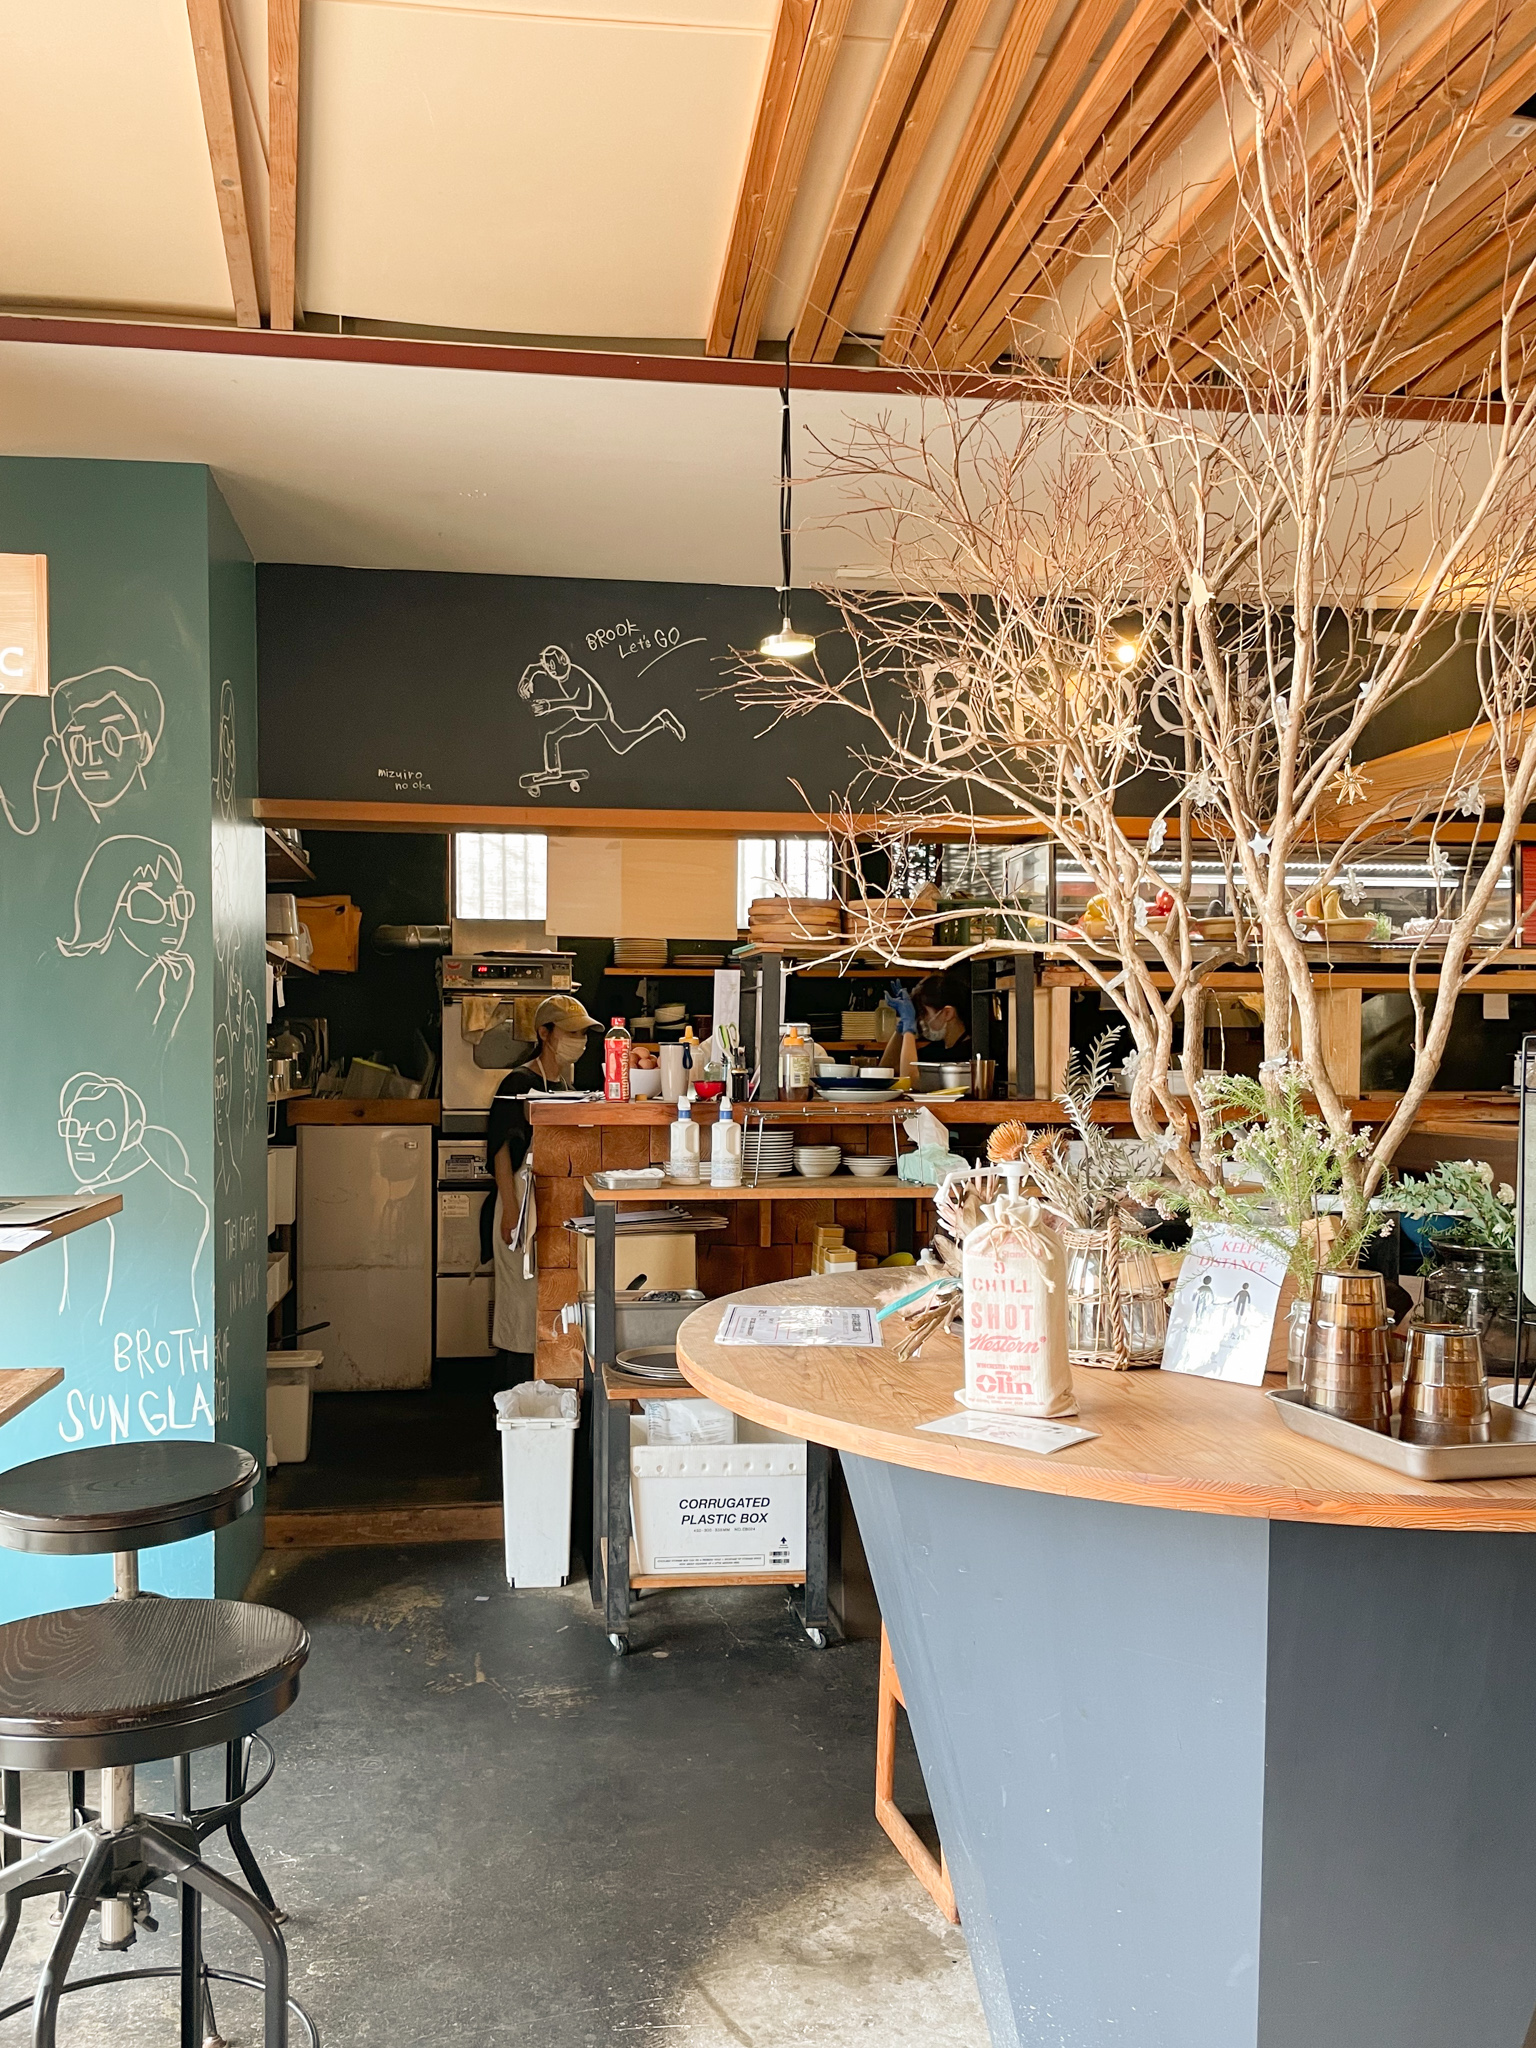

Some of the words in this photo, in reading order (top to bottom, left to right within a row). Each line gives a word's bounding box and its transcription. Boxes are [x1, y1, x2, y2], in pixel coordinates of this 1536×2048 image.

[586, 618, 641, 651] BROOK
[619, 635, 652, 659] Let's
[654, 627, 680, 648] GO
[378, 768, 423, 780] mizuiro
[395, 782, 409, 790] no
[1199, 1255, 1268, 1273] DISTANCE
[970, 1301, 1034, 1331] SHOT
[968, 1333, 1040, 1354] Western
[975, 1374, 1034, 1395] Olin
[679, 1497, 770, 1510] CORRUGATED
[681, 1513, 737, 1526] PLASTIC
[739, 1512, 769, 1524] BOX
